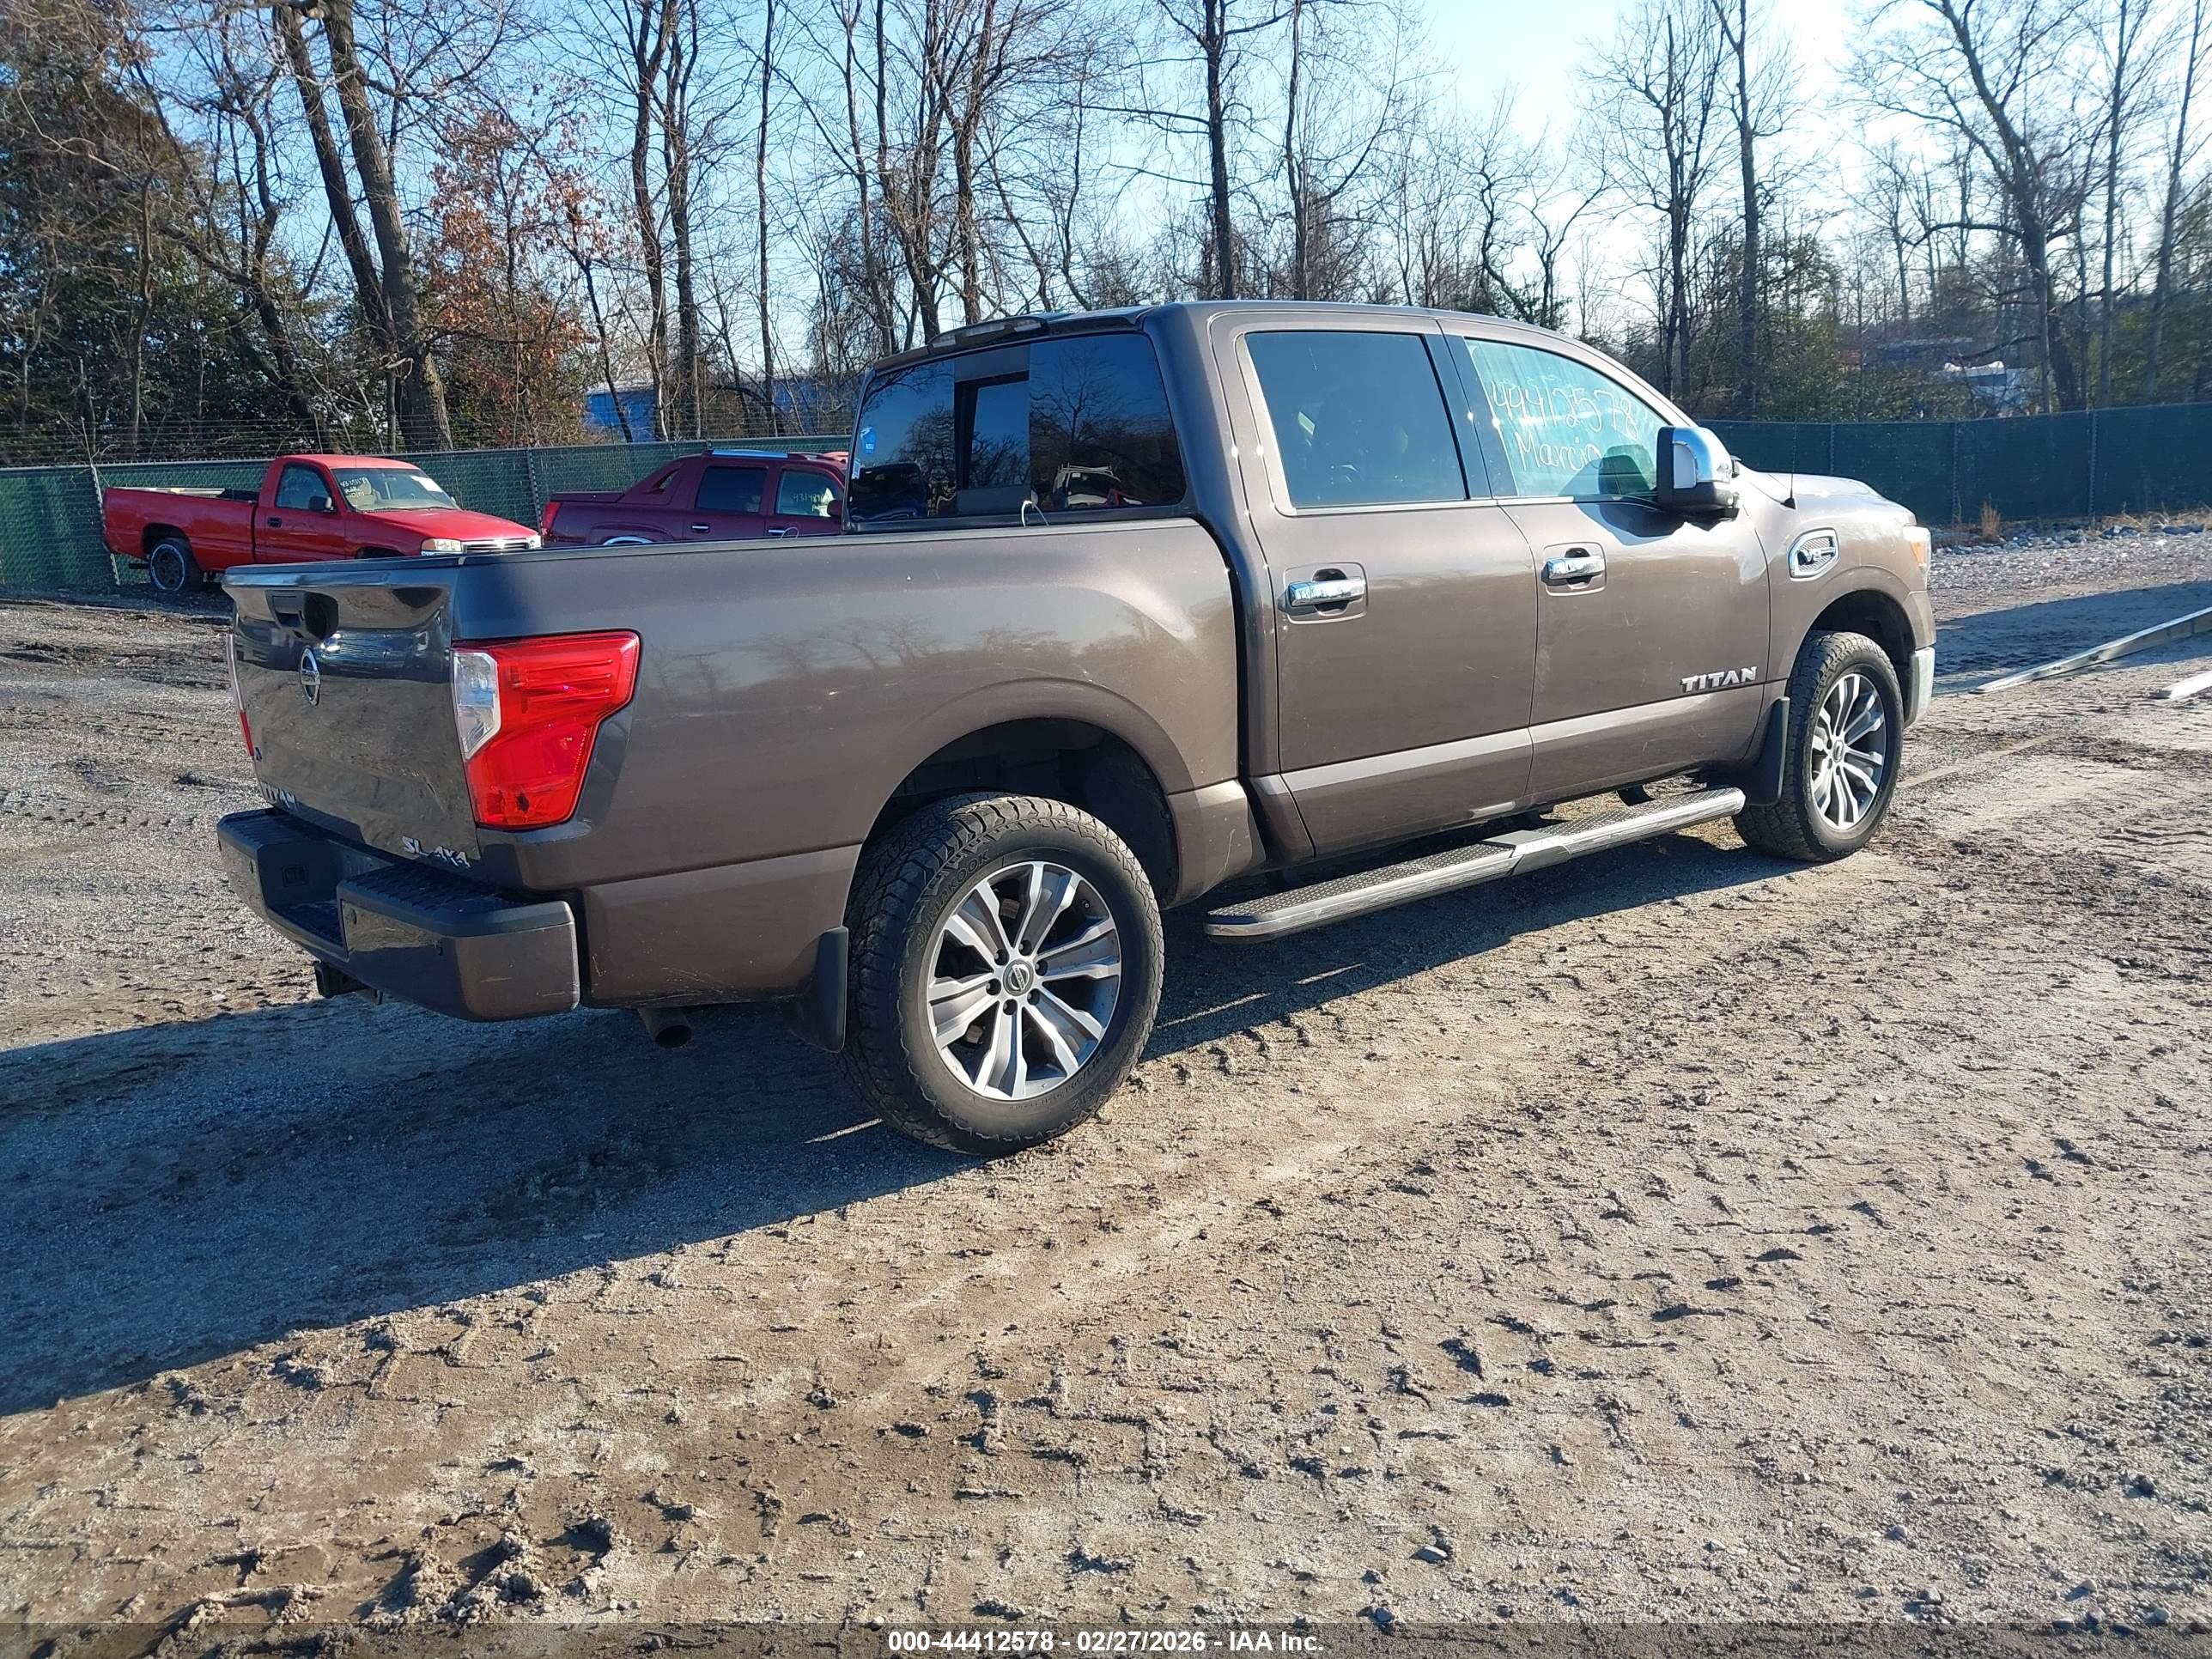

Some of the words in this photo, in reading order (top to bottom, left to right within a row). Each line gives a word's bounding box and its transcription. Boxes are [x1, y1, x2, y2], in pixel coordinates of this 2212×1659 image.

[1491, 380, 1639, 441] 44412578
[1680, 665, 1758, 693] TITAN
[401, 836, 430, 856] SL
